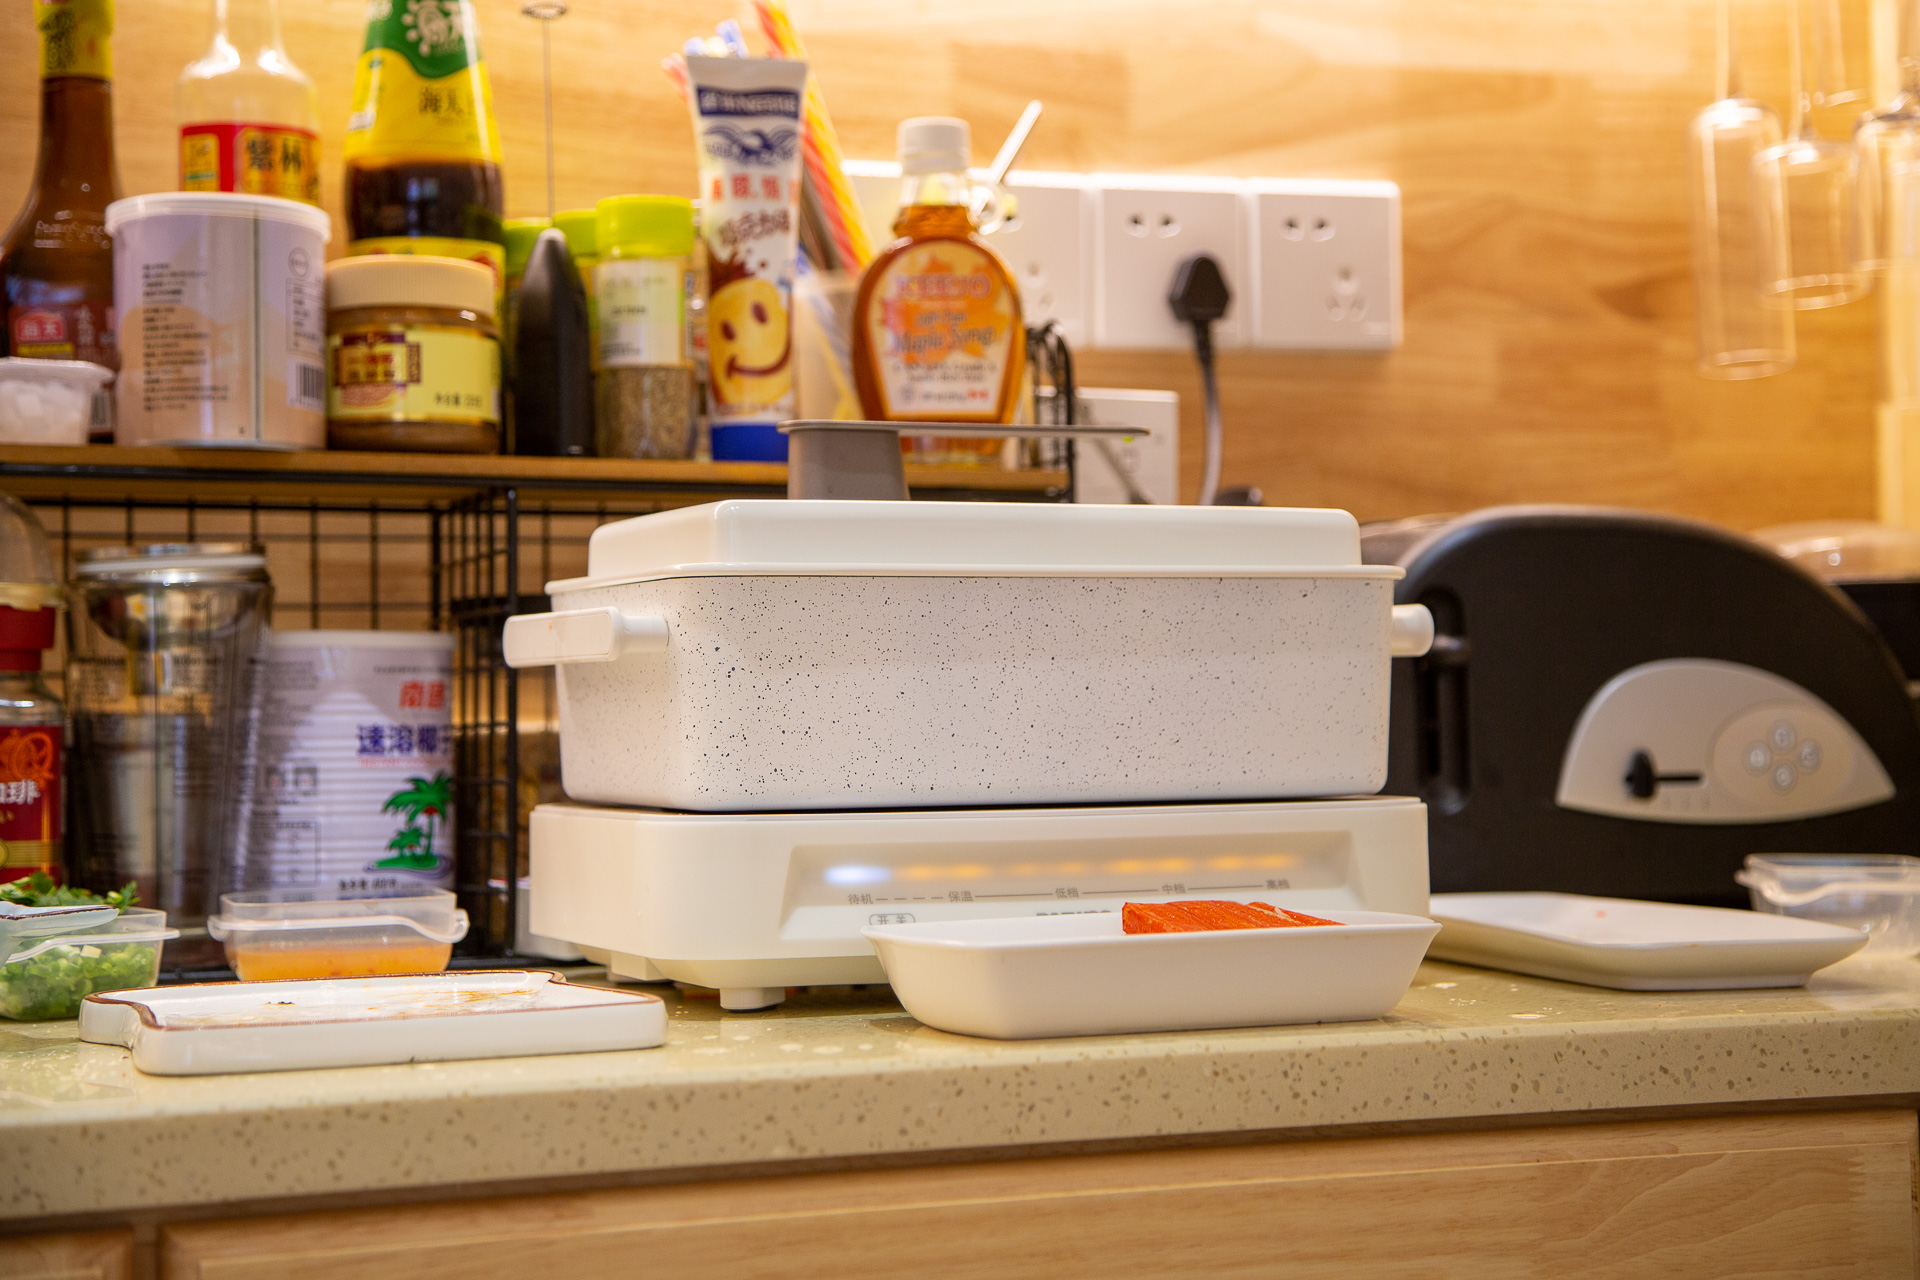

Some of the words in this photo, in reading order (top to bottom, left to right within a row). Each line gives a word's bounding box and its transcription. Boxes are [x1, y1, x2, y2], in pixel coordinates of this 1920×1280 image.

[848, 893, 874, 905] 待机
[948, 890, 974, 903] 保温
[1055, 887, 1080, 899] 低档
[1162, 883, 1186, 895] 中档
[1265, 878, 1290, 891] 高档
[877, 914, 907, 925] 开关
